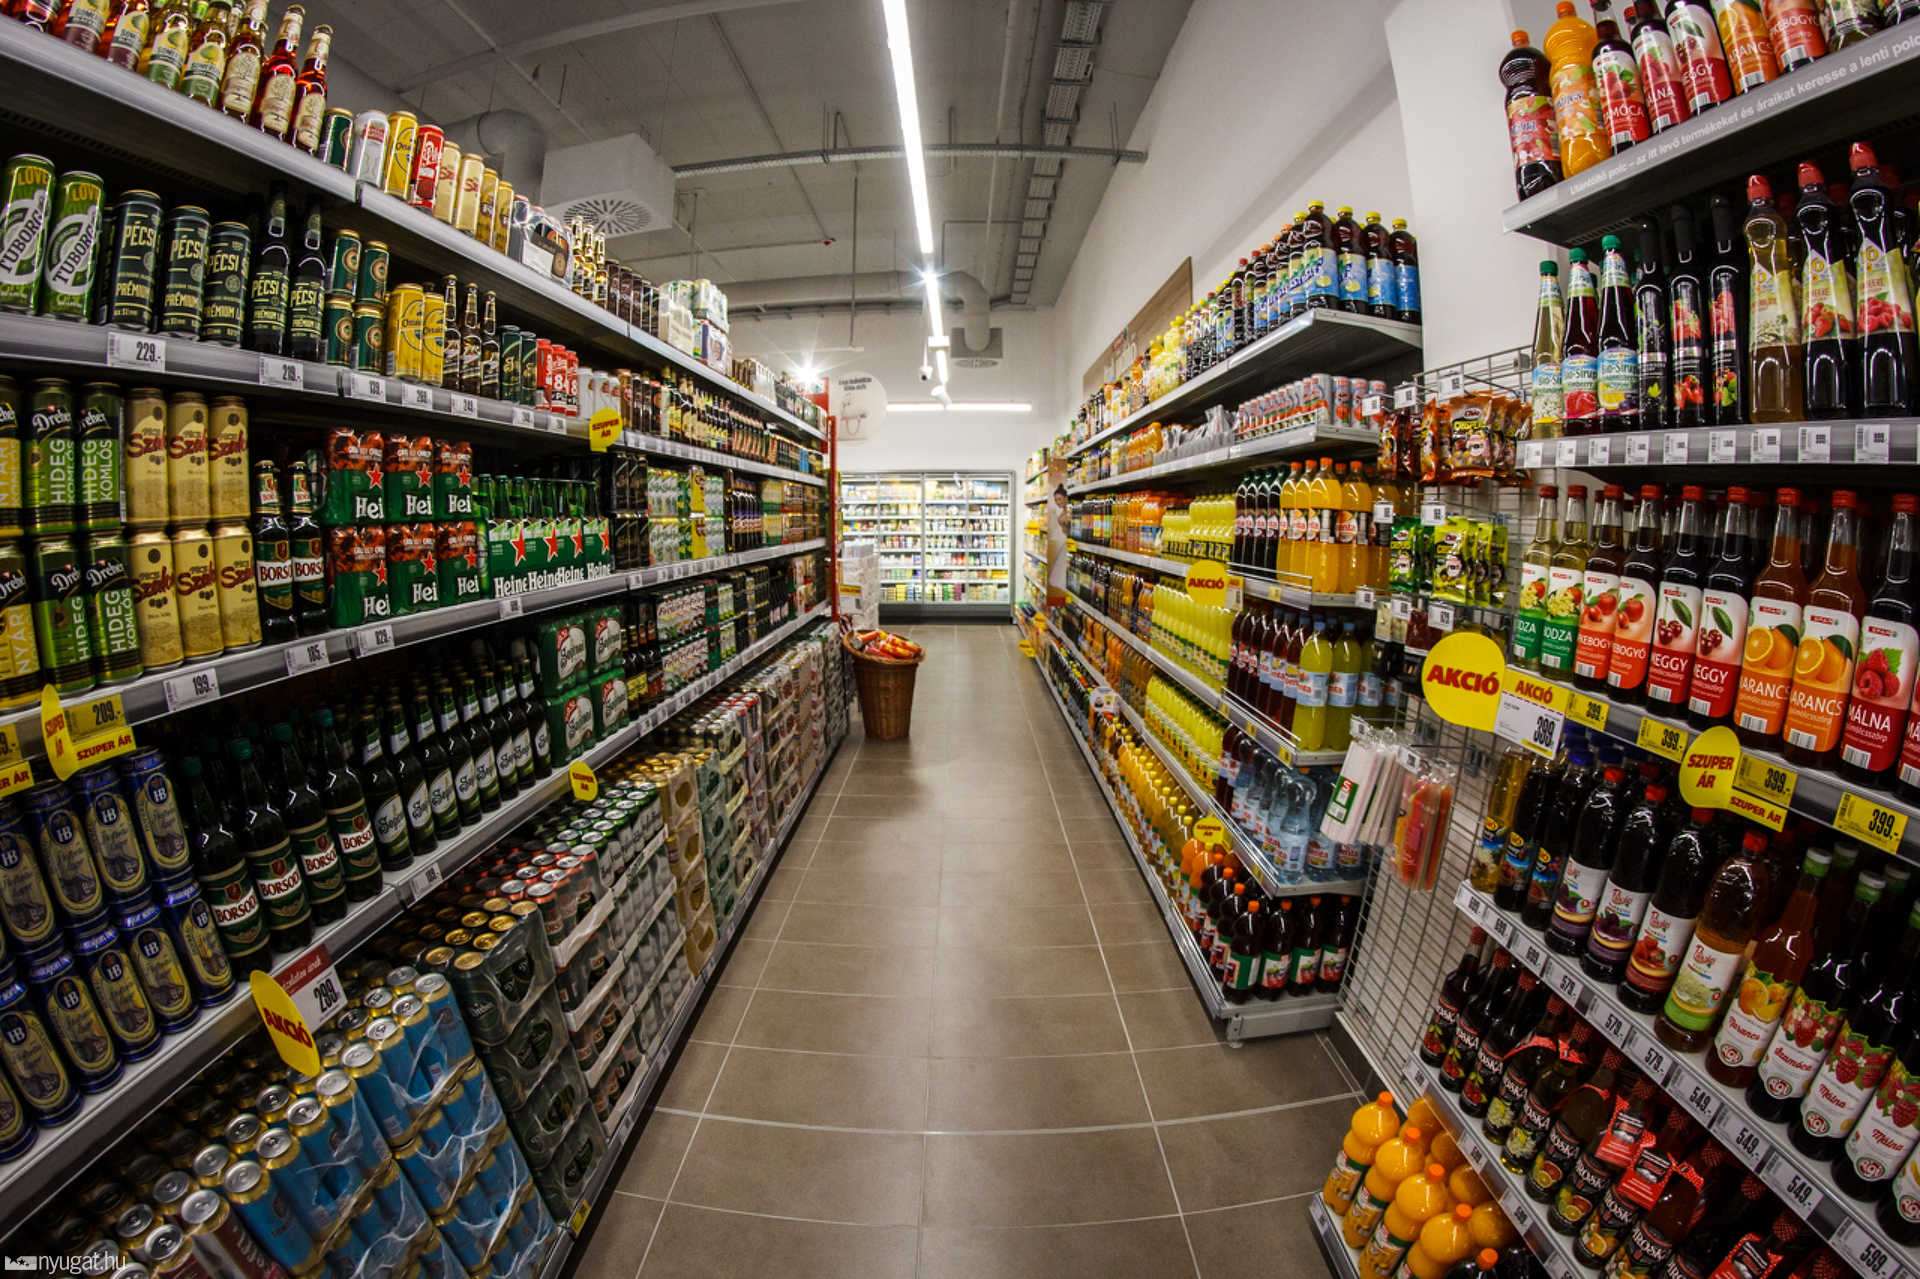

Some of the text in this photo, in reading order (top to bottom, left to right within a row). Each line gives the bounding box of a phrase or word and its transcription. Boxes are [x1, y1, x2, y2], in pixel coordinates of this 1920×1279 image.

[1797, 66, 1847, 94] keresse
[1850, 61, 1858, 73] a
[1859, 46, 1890, 68] lenti
[49, 439, 66, 504] HIDEG
[81, 439, 98, 503] HIDEG
[97, 439, 113, 501] KOMLÓS
[355, 495, 385, 520] Hei
[405, 494, 433, 515] Hei
[448, 494, 472, 514] Hei
[412, 581, 439, 604] Hei
[457, 574, 480, 596] Hei
[120, 588, 138, 650] KOMLÓS
[363, 593, 391, 618] Hei
[71, 596, 91, 661] HIDEG
[104, 591, 127, 654] HIDEG
[8, 606, 33, 675] NYÁRI
[1426, 664, 1500, 696] AKCIÓ
[1514, 680, 1553, 705] AKCIÓ
[76, 734, 132, 761] SZUPER ÁR
[1687, 753, 1735, 771] SZUPER
[13, 770, 30, 785] ÁR
[1696, 771, 1716, 789] ÁR
[1763, 767, 1792, 796] 399.-
[1729, 795, 1782, 825] SZUPER ÁR
[1868, 808, 1900, 840] 399.-
[262, 1007, 313, 1049] AKCIÓ
[1689, 1085, 1712, 1115] 549.-
[1735, 1127, 1760, 1160] 549.-
[1786, 1175, 1813, 1209] 549.-
[1859, 1242, 1888, 1277] 599.-
